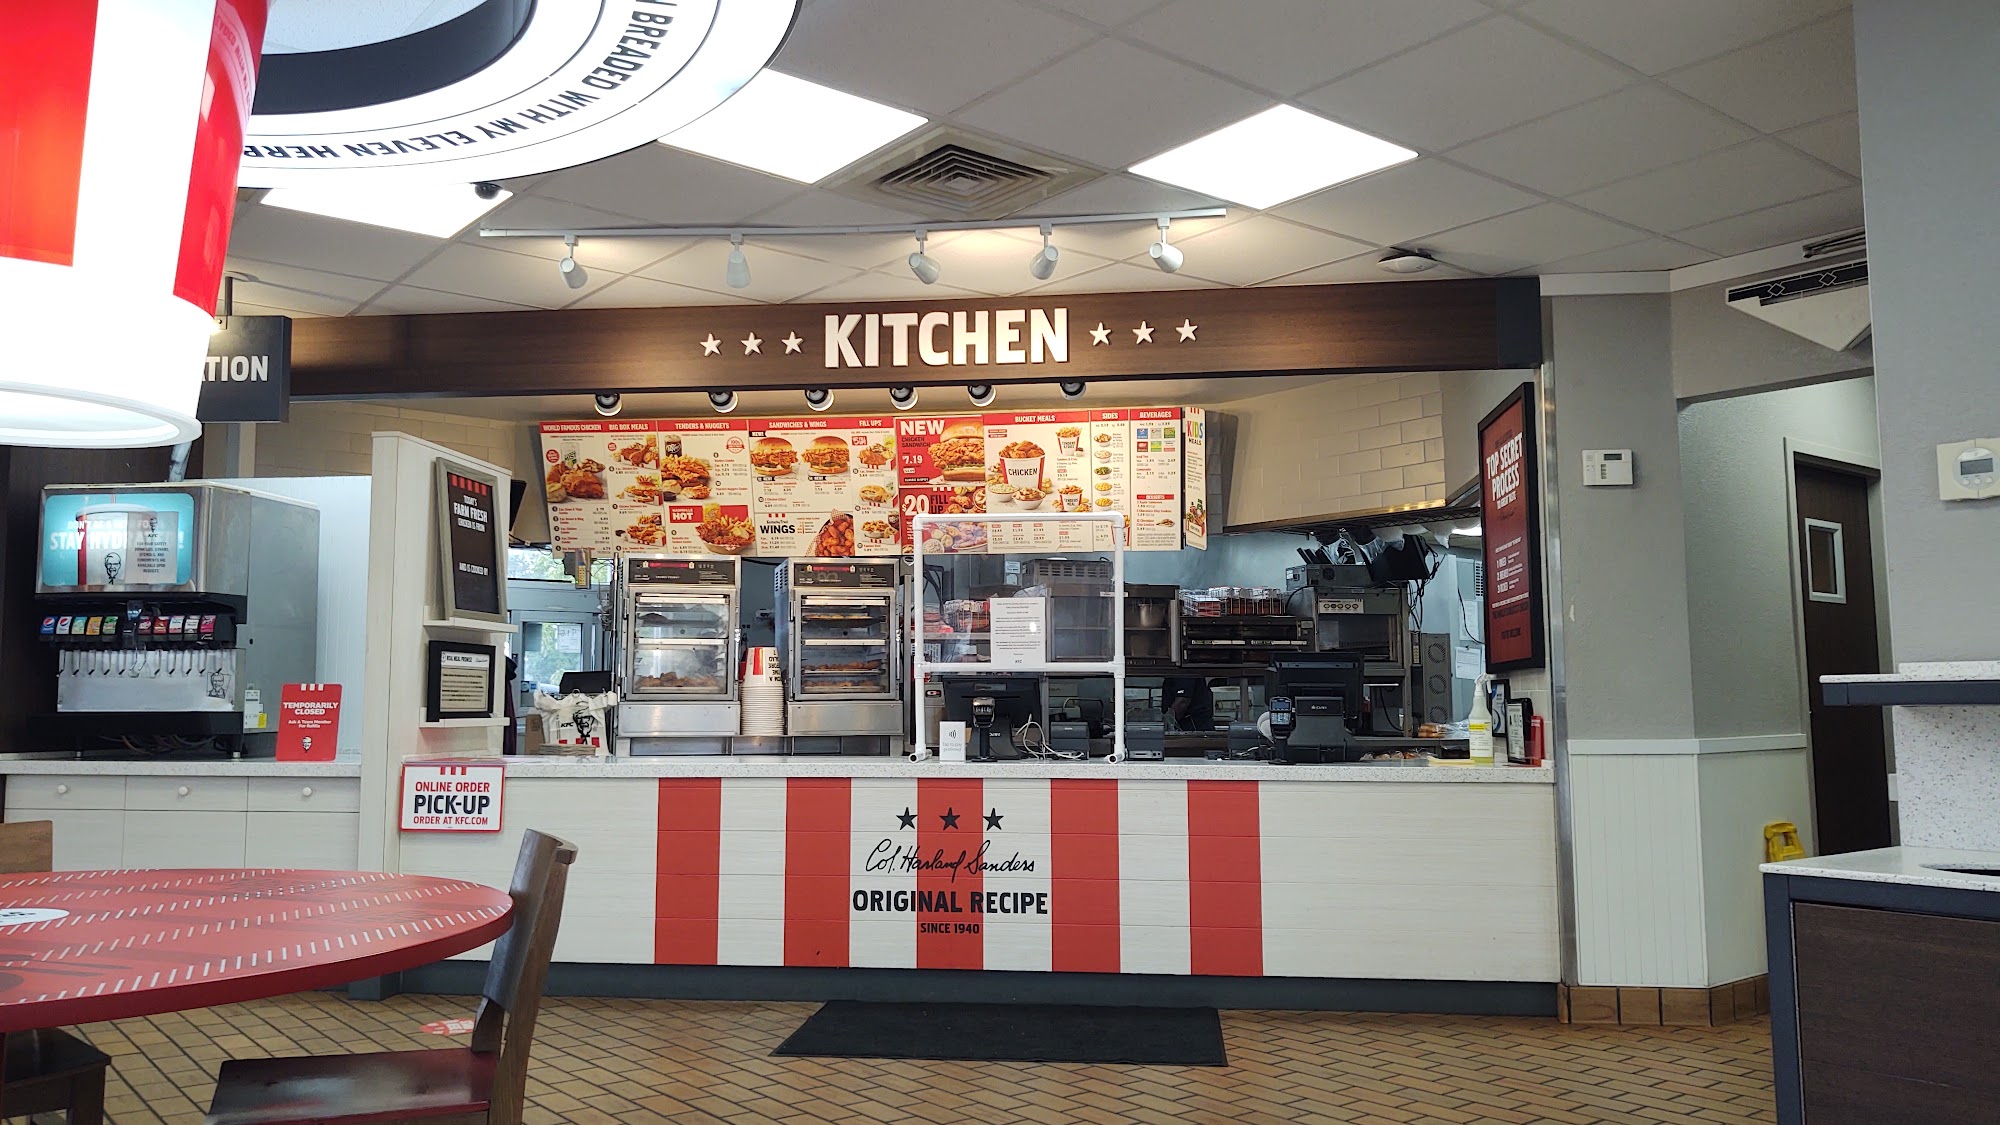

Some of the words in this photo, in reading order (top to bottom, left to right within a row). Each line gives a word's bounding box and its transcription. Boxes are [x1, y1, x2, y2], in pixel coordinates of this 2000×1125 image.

[582, 11, 674, 90] BREADED
[516, 90, 601, 124] WITH
[474, 117, 529, 139] MY
[343, 130, 477, 157] ELEVEN
[825, 307, 1068, 368] KITCHEN
[202, 355, 269, 382] TION
[870, 419, 882, 427] UPS
[900, 420, 945, 436] NEW
[1014, 415, 1036, 423] BUCKET
[1187, 421, 1204, 439] KIDS
[1188, 438, 1202, 446] MEALS
[902, 455, 923, 464] $7.19
[1486, 451, 1500, 480] TOP
[1500, 431, 1523, 471] SECRET
[1008, 468, 1038, 476] CHICKEN
[1492, 462, 1520, 502] PROCESS
[453, 502, 470, 518] FARM
[470, 507, 488, 523] FRESH
[902, 494, 930, 516] $20
[930, 495, 949, 504] FILL
[930, 505, 944, 514] UP
[672, 512, 694, 520] HOT
[760, 525, 795, 534] WINGS
[50, 532, 85, 550] STAY
[415, 781, 452, 792] ONLINE
[455, 782, 490, 792] ORDER
[414, 795, 490, 814] PICK-UP
[413, 816, 440, 825] ORDER
[443, 816, 453, 825] AT
[455, 816, 488, 825] KFC.COM
[866, 838, 901, 874] Col.
[899, 845, 967, 883] Harland
[963, 839, 1035, 875] Sanders
[853, 890, 963, 912] ORIGINAL
[970, 891, 1048, 914] RECIPE
[920, 923, 950, 933] SINCE
[954, 923, 980, 934] 1940
